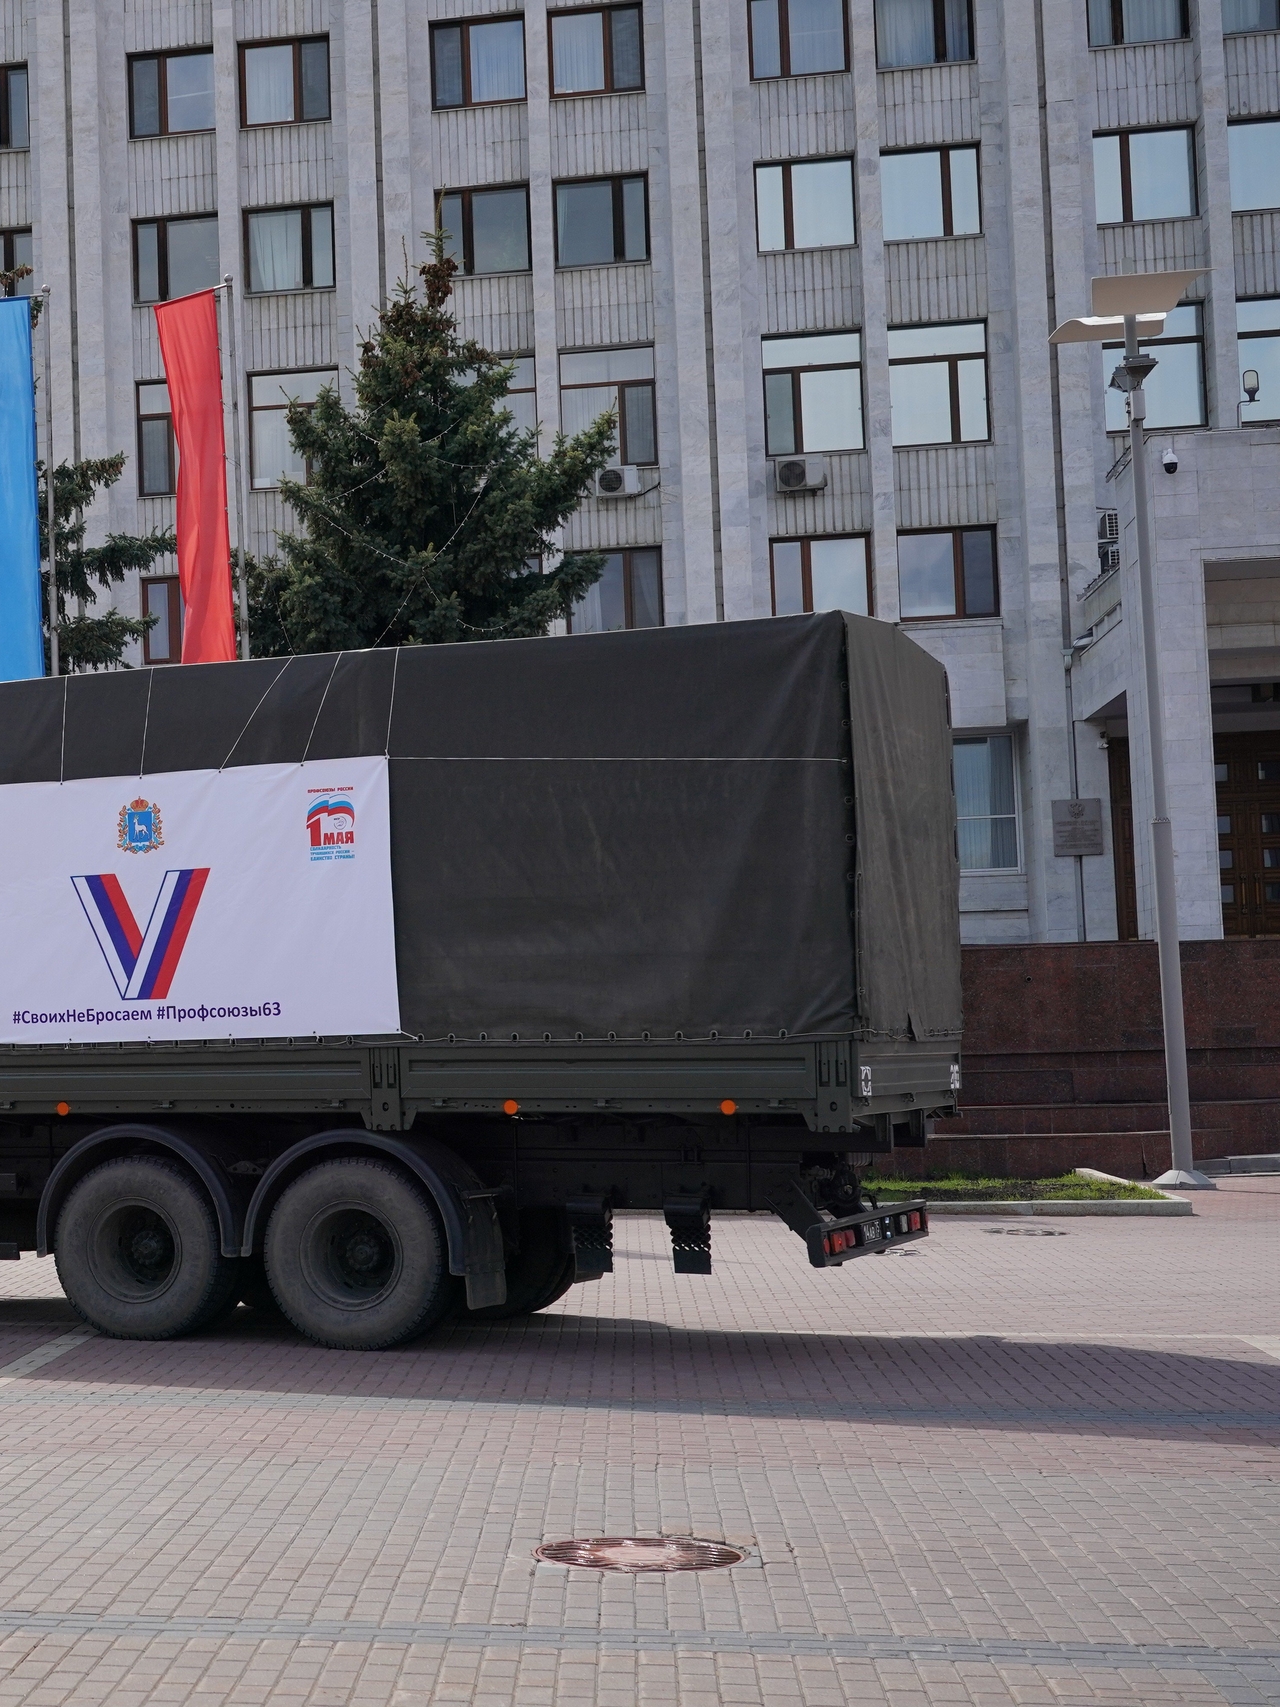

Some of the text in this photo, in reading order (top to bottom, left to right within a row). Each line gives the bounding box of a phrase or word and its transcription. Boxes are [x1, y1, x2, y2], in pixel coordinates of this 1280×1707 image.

[306, 817, 354, 846] 1 МАЯ
[70, 868, 211, 1000] V
[13, 1002, 282, 1025] #СвоихНеБросаем #Профсоюзы63
